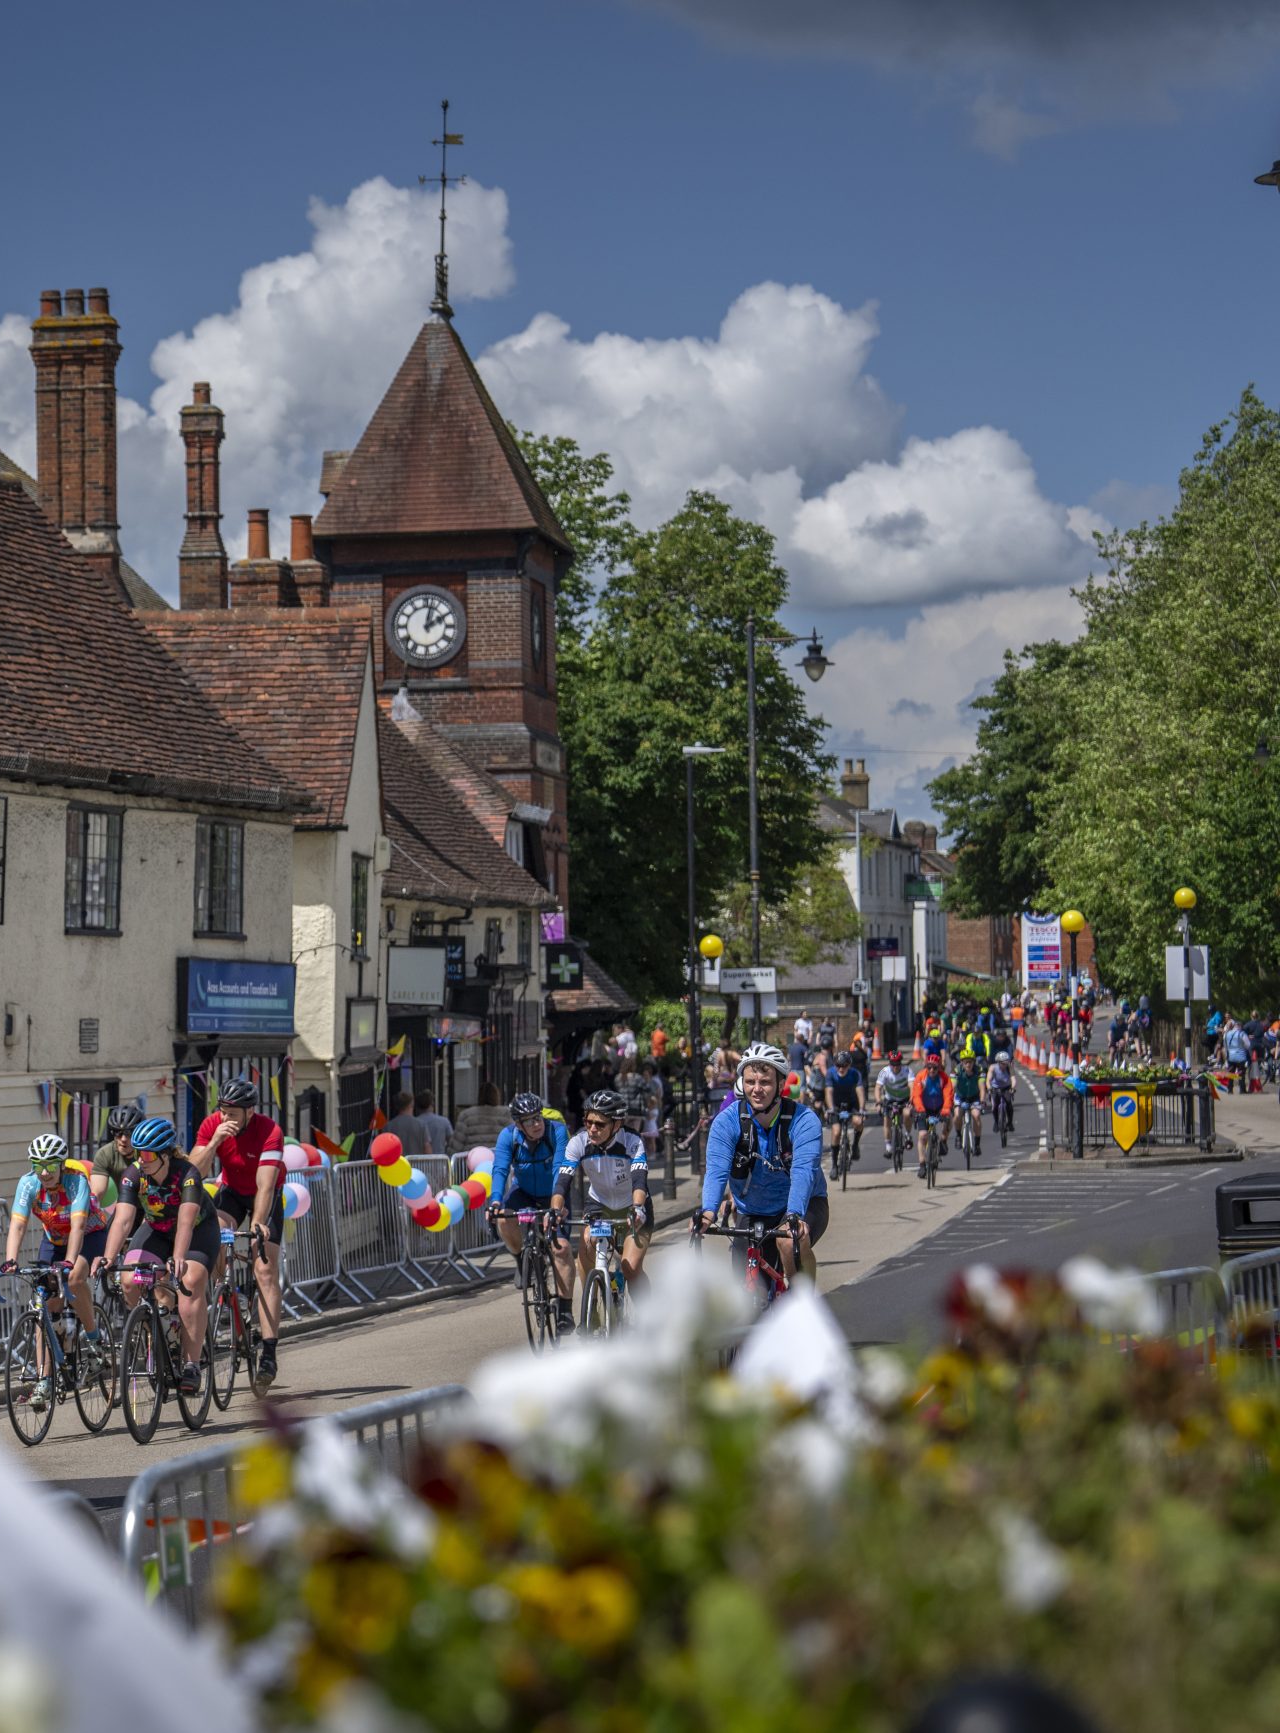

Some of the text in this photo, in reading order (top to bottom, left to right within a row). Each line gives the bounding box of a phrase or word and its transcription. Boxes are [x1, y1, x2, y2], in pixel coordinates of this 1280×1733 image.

[1029, 926, 1058, 934] TESCO
[722, 970, 773, 979] Supermarket
[219, 980, 239, 994] Accounts
[240, 981, 249, 994] and
[269, 982, 277, 996] Ltd
